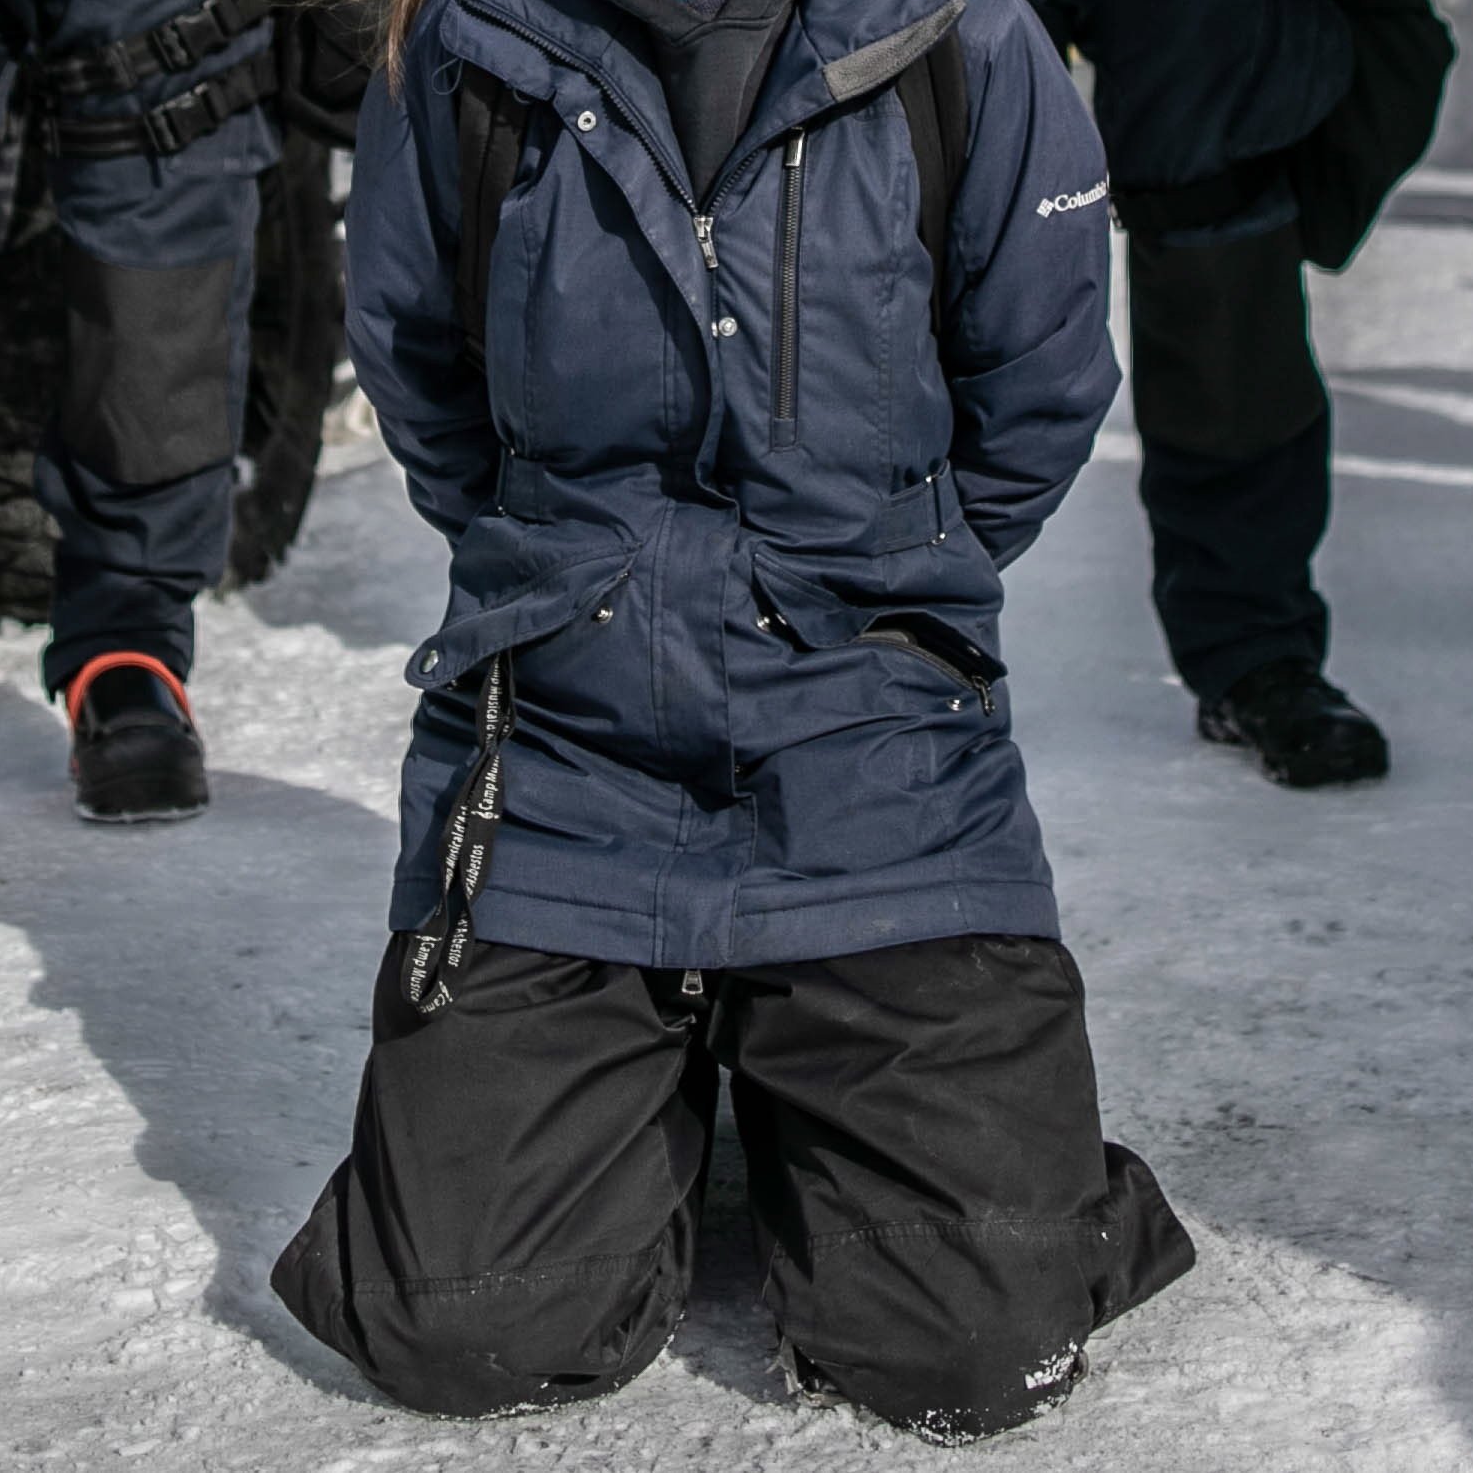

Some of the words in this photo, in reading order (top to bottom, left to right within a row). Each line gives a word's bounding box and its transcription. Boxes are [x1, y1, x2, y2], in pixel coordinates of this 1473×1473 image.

[478, 783, 500, 811] Camp
[445, 831, 464, 869] Musical
[413, 941, 435, 967] Camp
